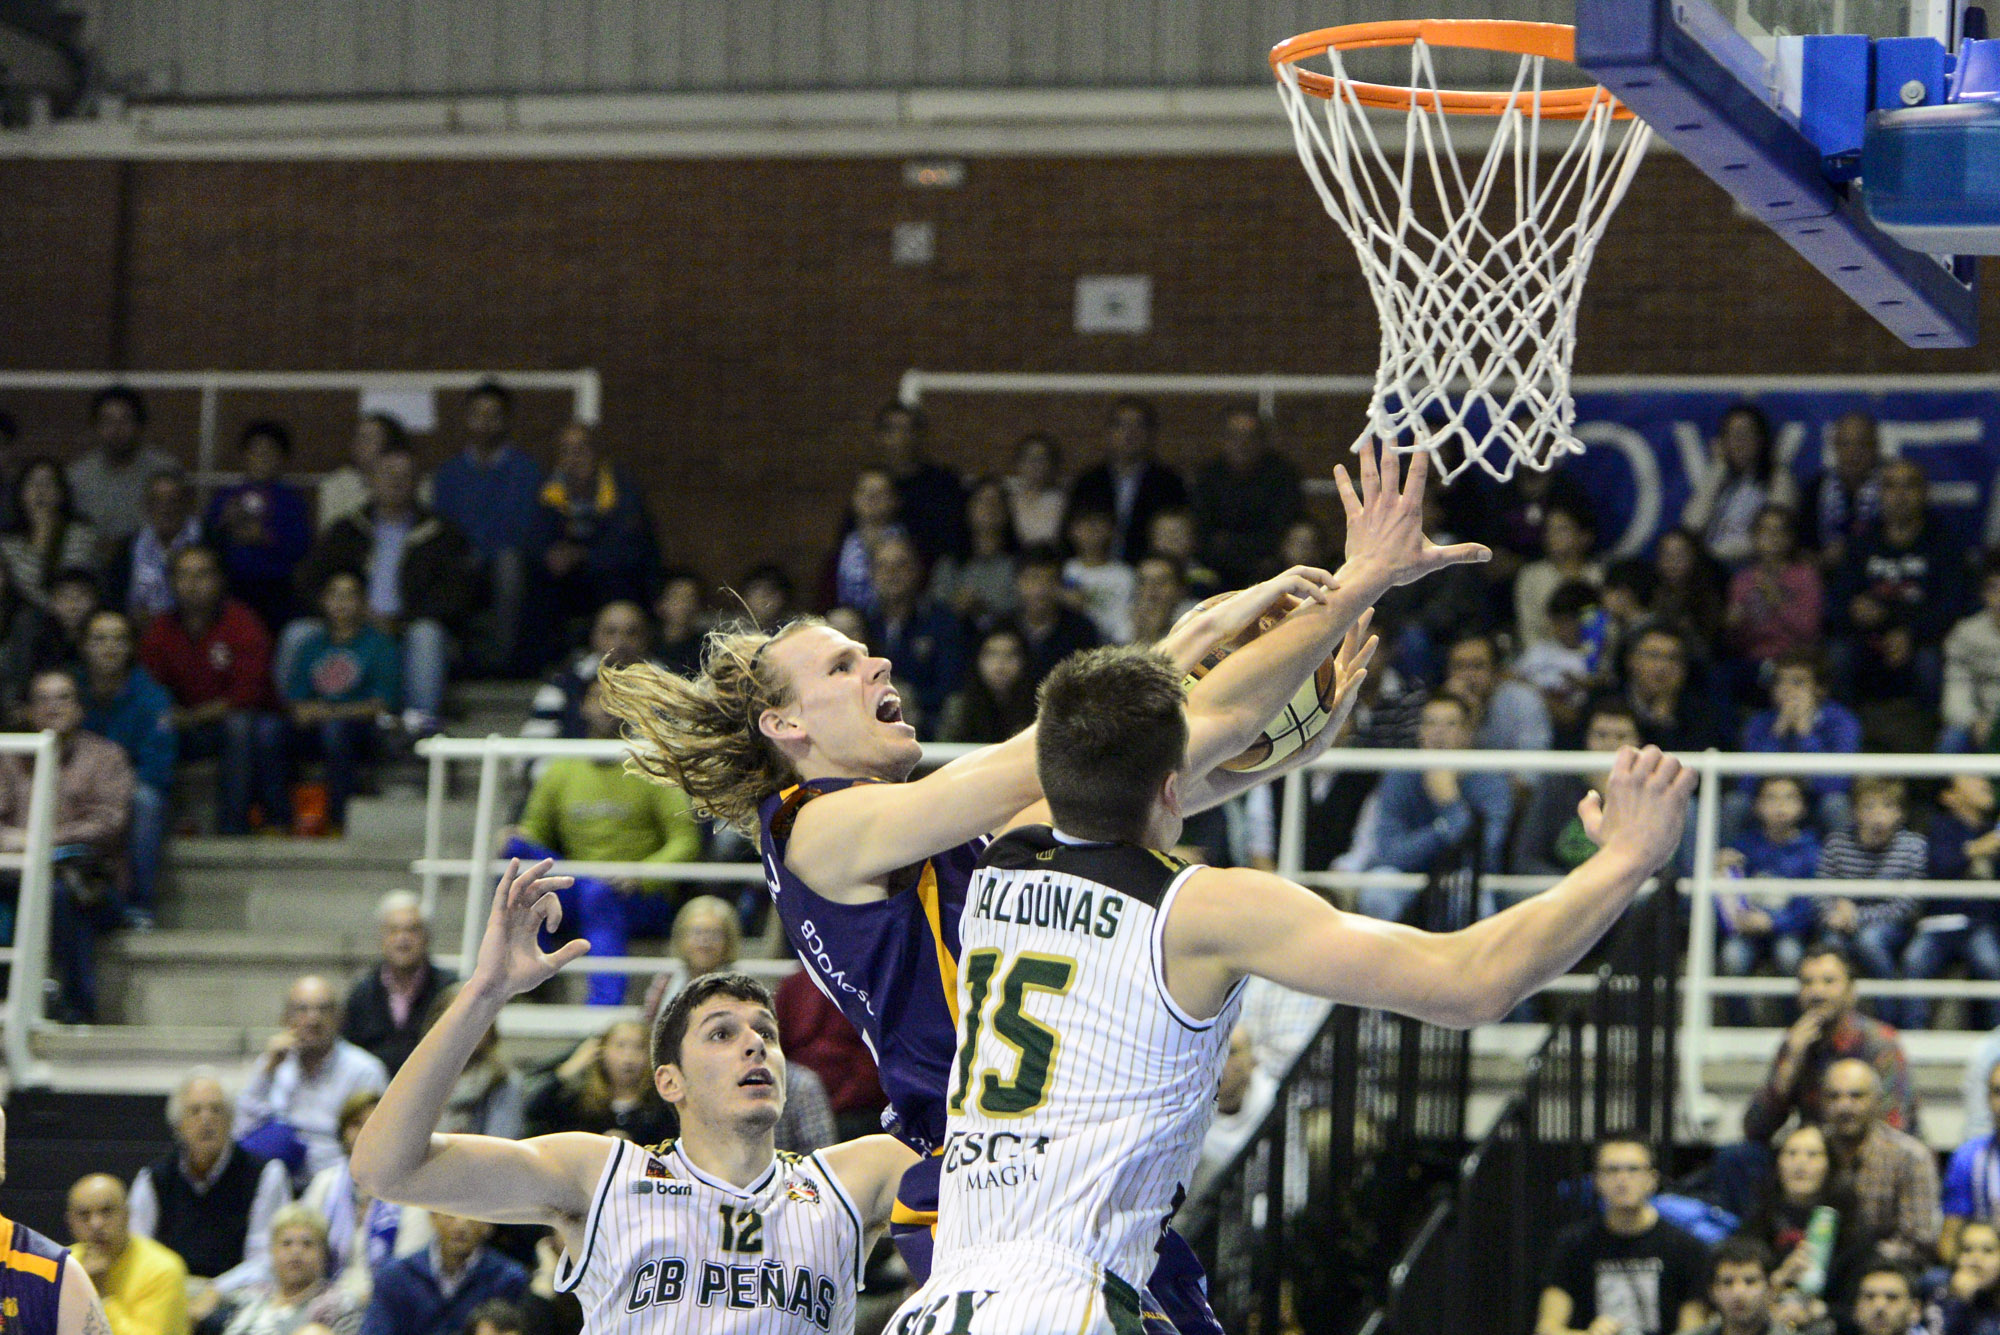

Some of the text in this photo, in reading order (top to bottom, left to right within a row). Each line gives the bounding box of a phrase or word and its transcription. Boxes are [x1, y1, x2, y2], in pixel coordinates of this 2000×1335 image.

[947, 947, 1077, 1119] 15
[719, 1203, 763, 1253] 12
[625, 1257, 687, 1313] CB
[696, 1256, 837, 1332] PEÑAS
